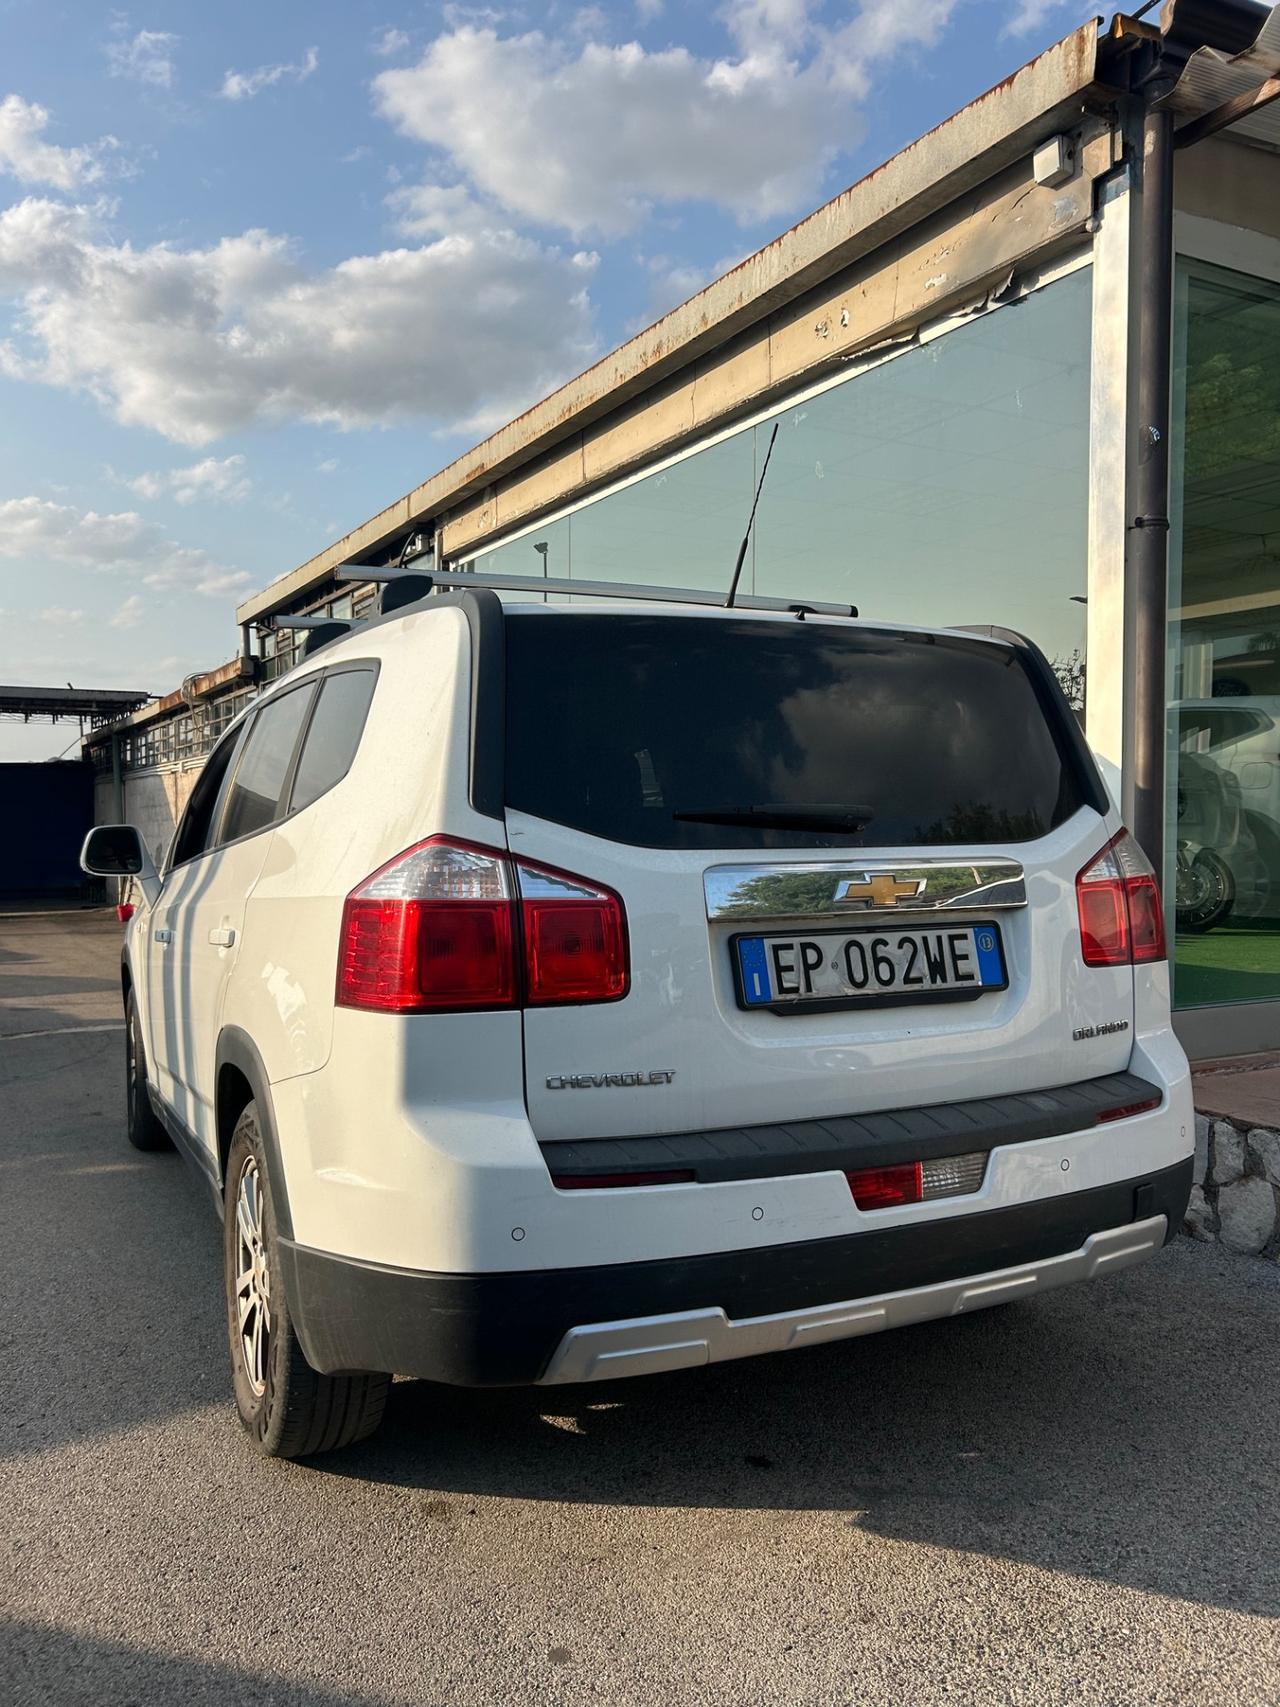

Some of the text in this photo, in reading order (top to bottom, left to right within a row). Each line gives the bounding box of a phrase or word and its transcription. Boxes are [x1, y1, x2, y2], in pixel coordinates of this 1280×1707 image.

[771, 942, 823, 995] EP
[844, 933, 974, 989] 062WE
[1073, 1019, 1129, 1041] ORLANDO
[546, 1069, 676, 1090] CHEVROLET
